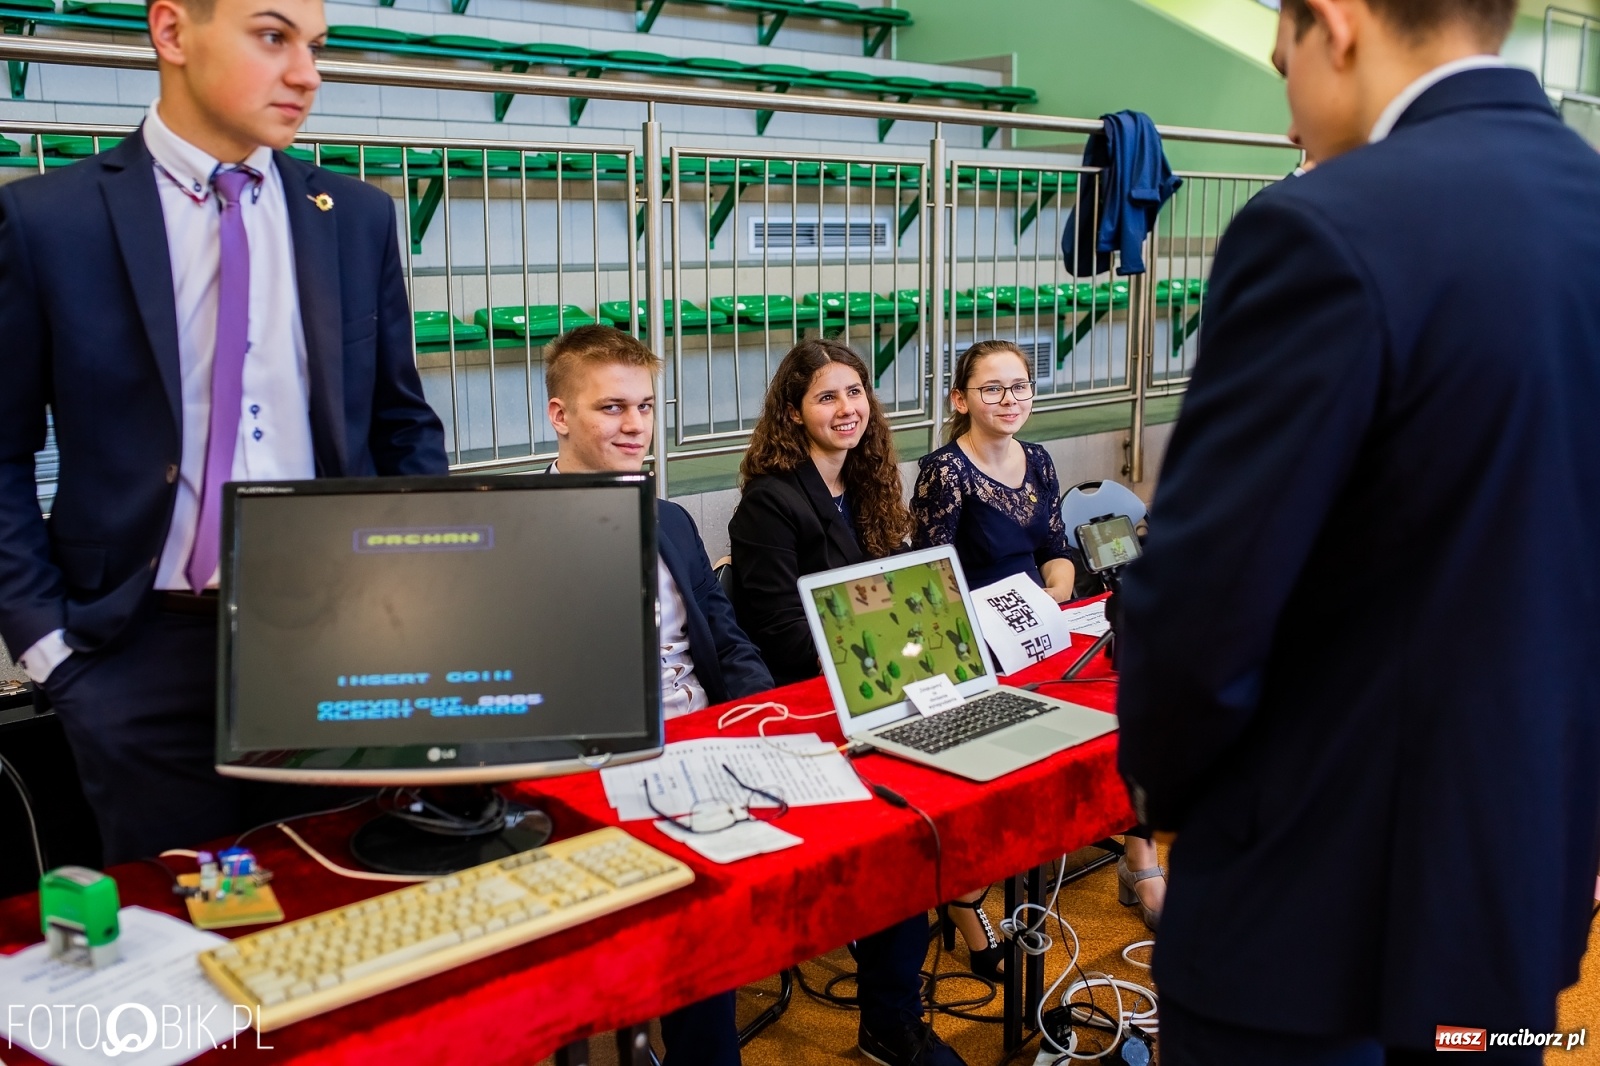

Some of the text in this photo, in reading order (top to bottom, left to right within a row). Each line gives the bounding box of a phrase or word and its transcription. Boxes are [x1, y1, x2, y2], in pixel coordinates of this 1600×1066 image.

[367, 532, 480, 546] PACMAN
[337, 669, 513, 687] INSERT COIN
[317, 693, 544, 712] COPYRIGHT 2005
[441, 748, 457, 760] LG
